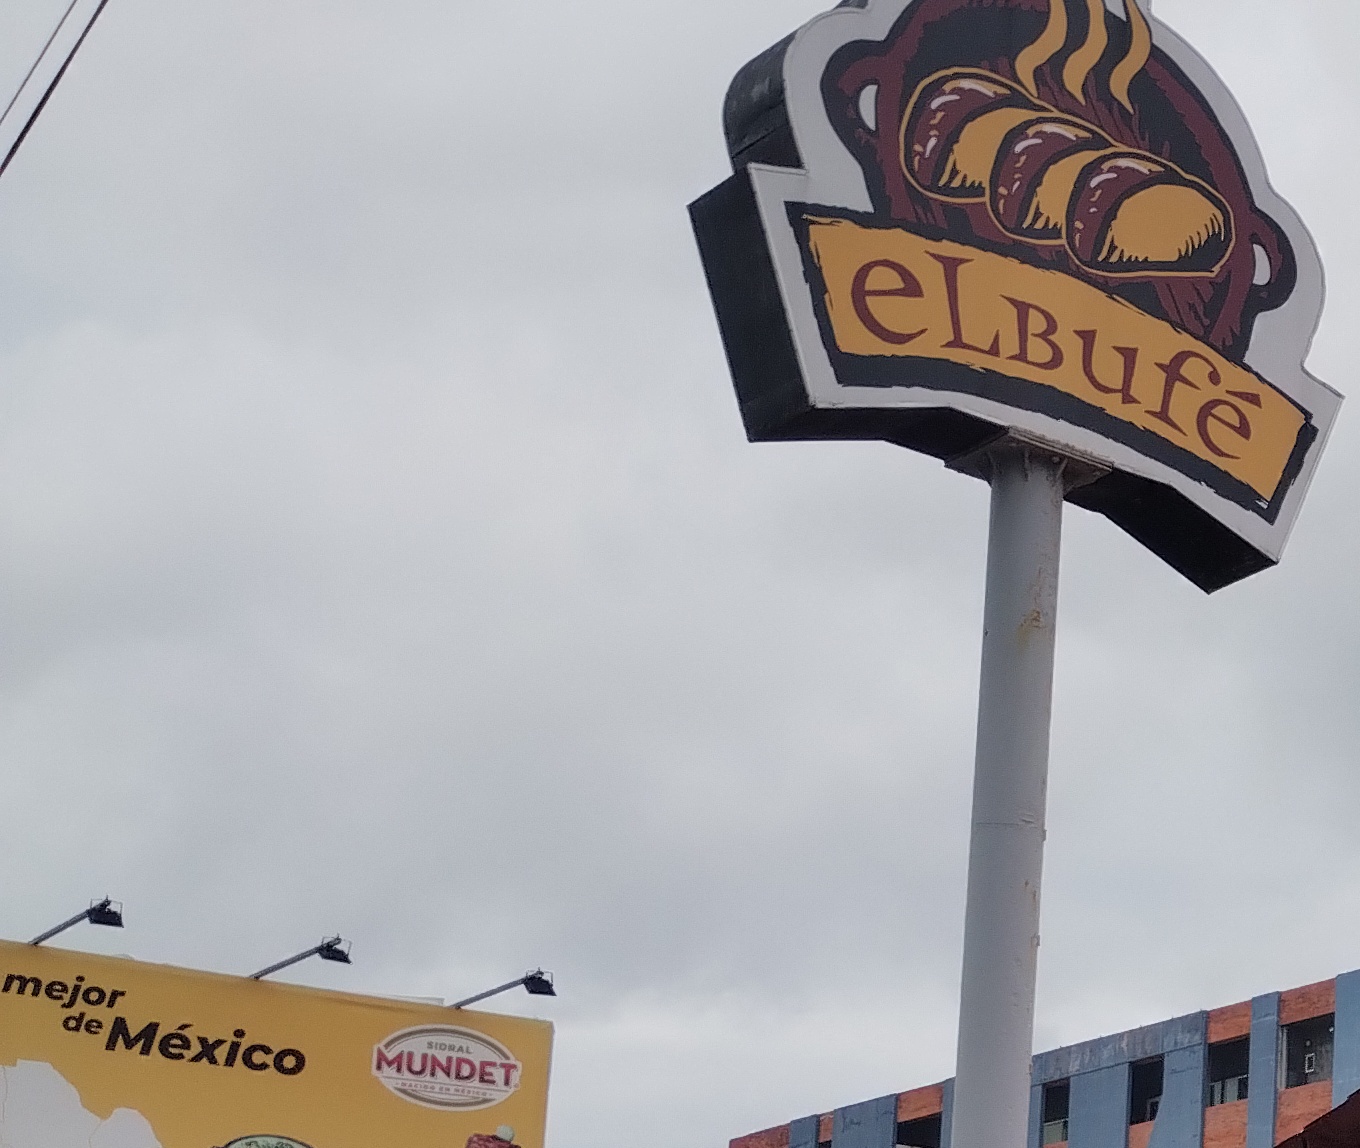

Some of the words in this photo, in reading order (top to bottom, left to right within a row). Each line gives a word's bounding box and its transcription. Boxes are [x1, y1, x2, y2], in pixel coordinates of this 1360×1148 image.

[2, 974, 127, 1009] mejor
[62, 1012, 103, 1035] de
[104, 1016, 306, 1076] México
[426, 1040, 474, 1054] SIDRAL
[376, 1046, 518, 1087] MUNDET
